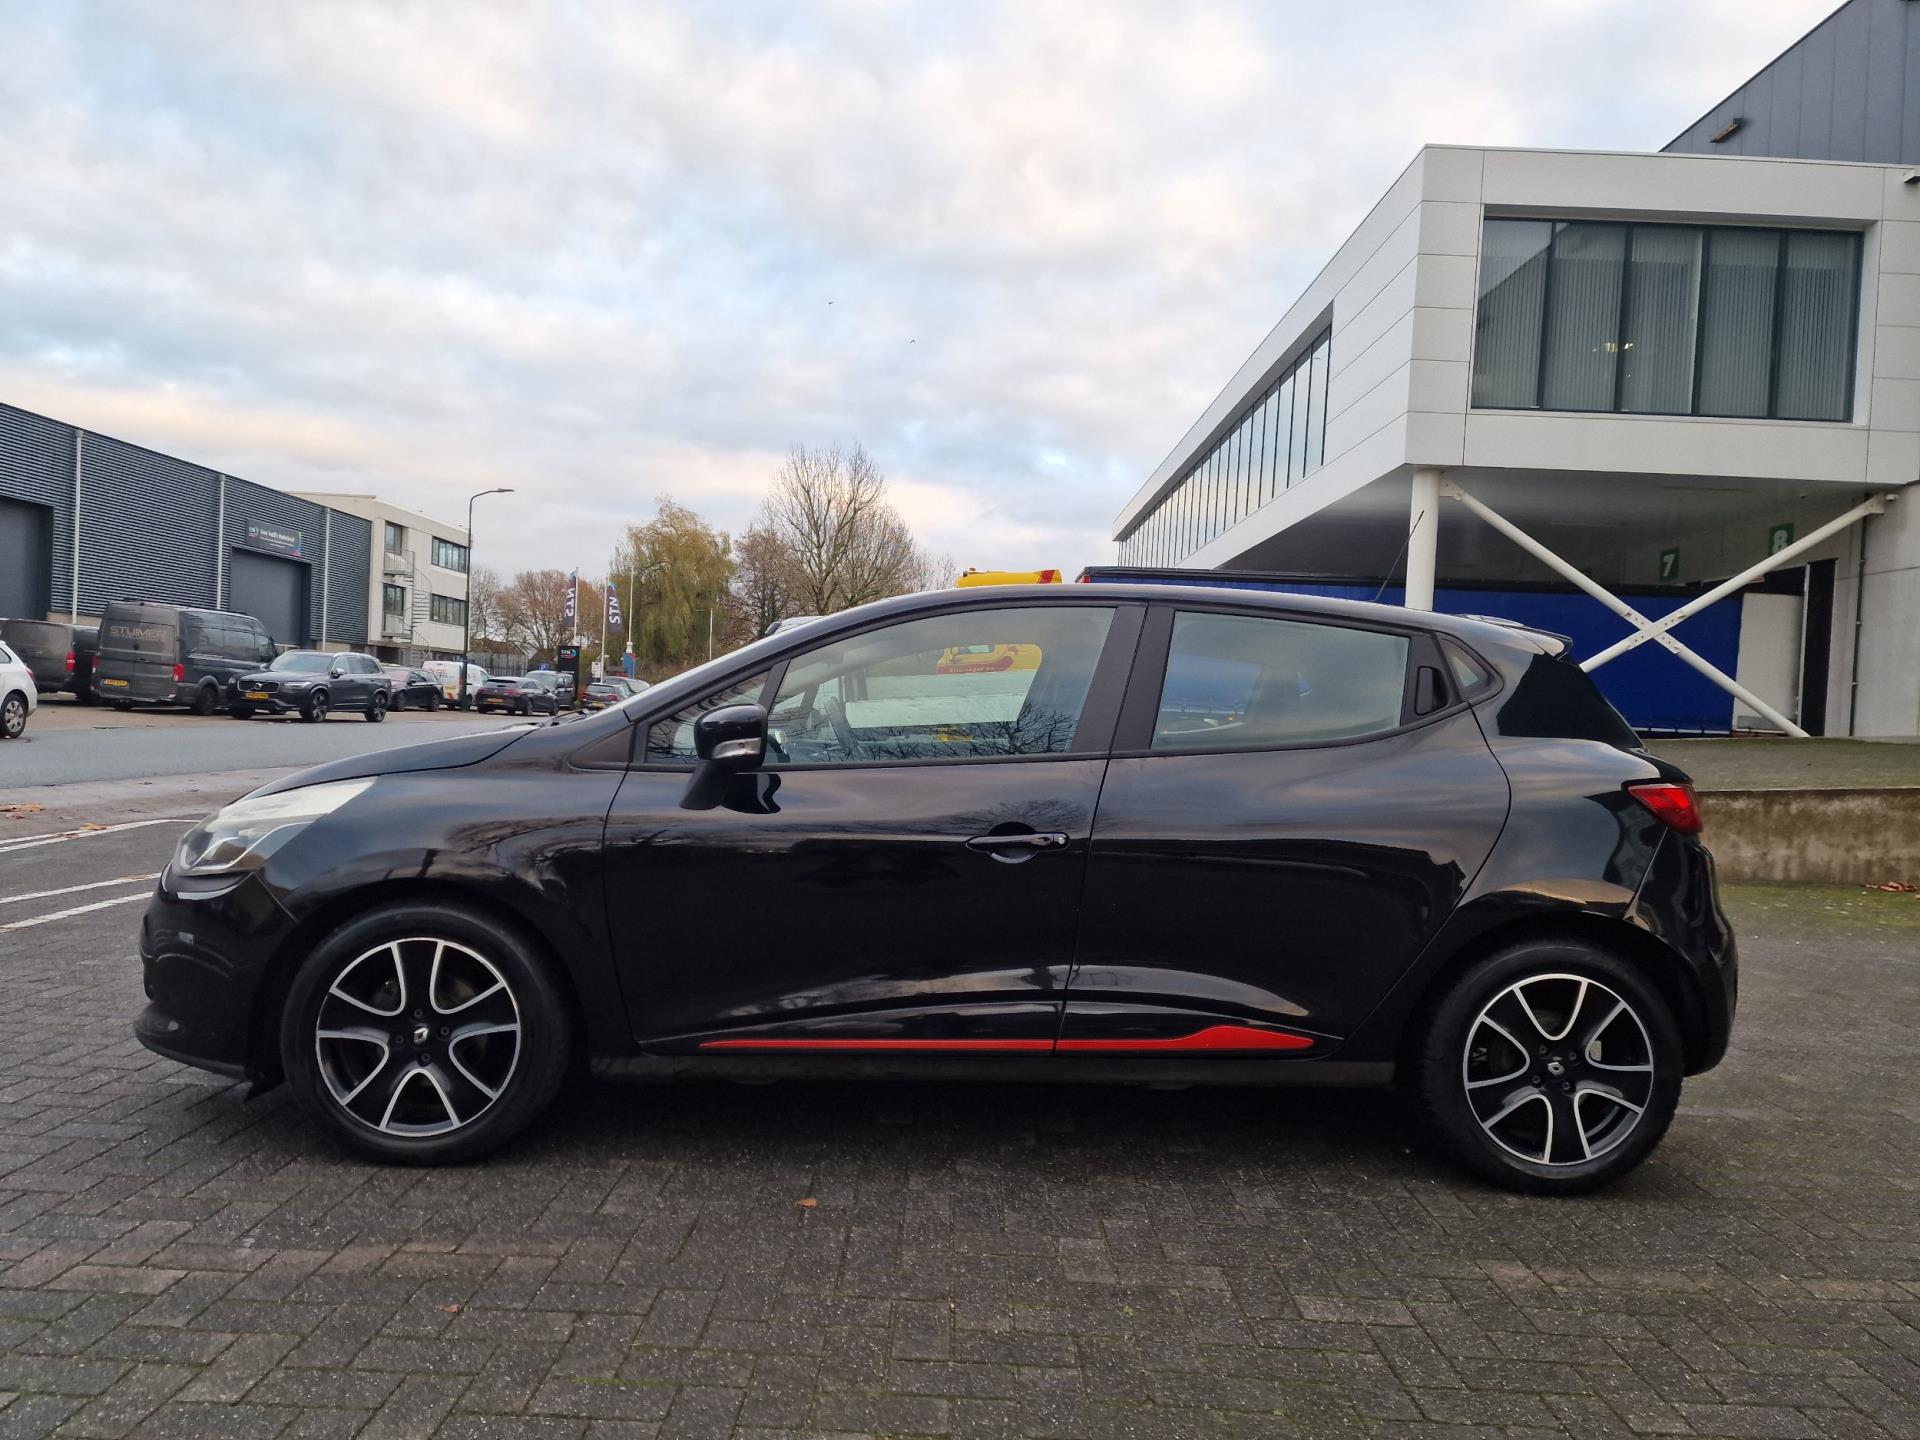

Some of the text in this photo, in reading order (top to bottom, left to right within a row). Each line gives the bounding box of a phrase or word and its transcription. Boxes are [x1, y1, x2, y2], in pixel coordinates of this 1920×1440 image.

[1772, 529, 1788, 554] 8
[1662, 553, 1675, 577] 7
[609, 596, 620, 624] STN
